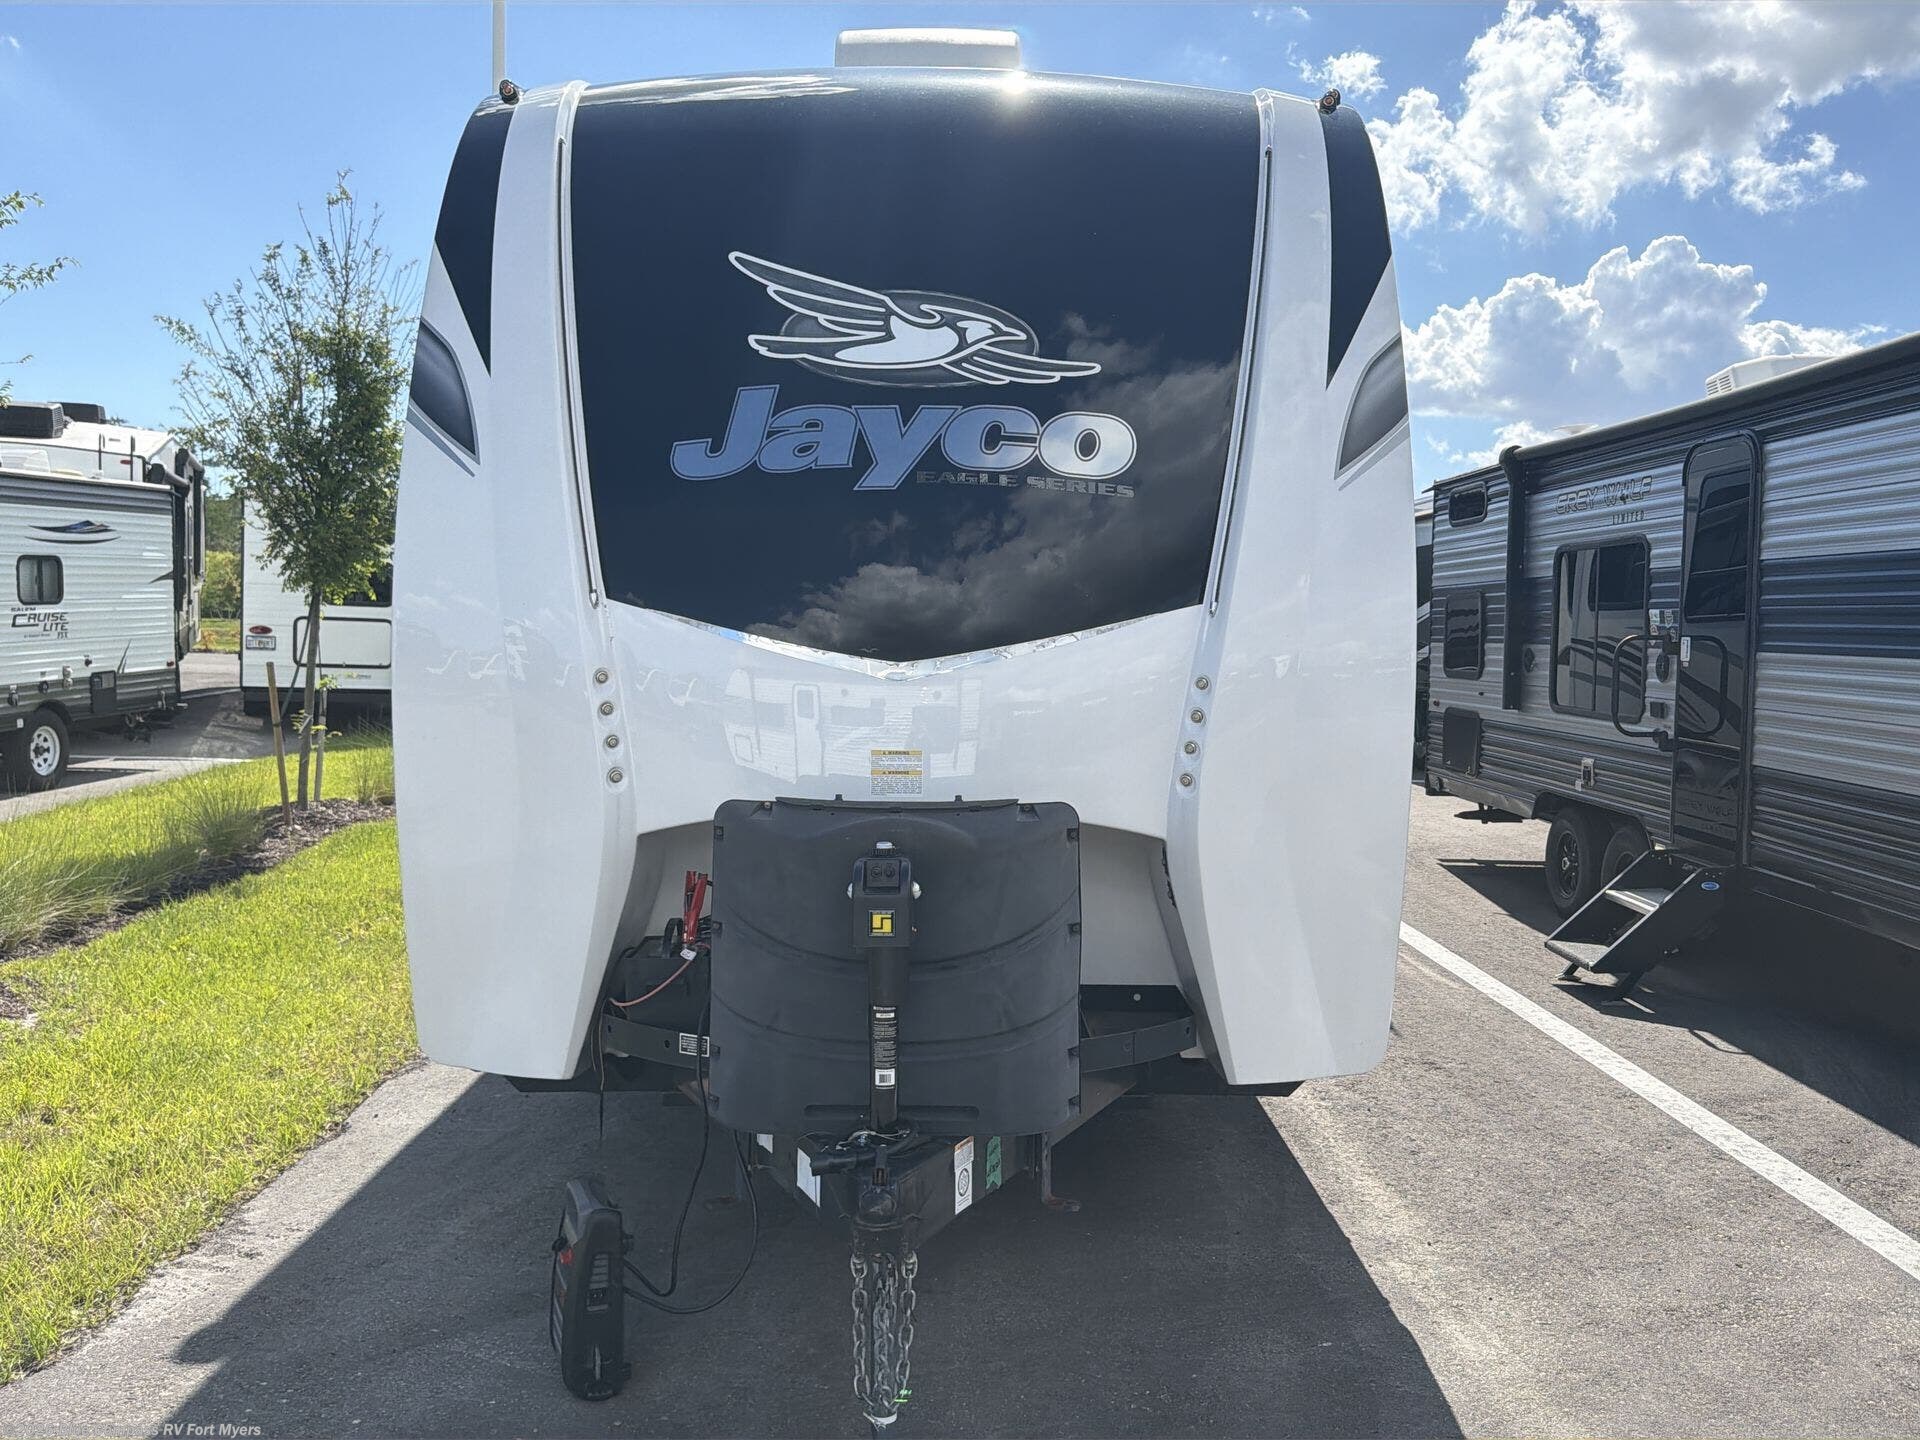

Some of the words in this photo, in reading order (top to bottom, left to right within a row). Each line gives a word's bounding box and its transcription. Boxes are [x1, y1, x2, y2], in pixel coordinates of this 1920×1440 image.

[670, 384, 1138, 490] Jayco
[916, 471, 1019, 487] EAGLE
[1026, 476, 1135, 498] SERIES
[11, 612, 69, 628] CRUISE
[43, 622, 69, 631] LITE
